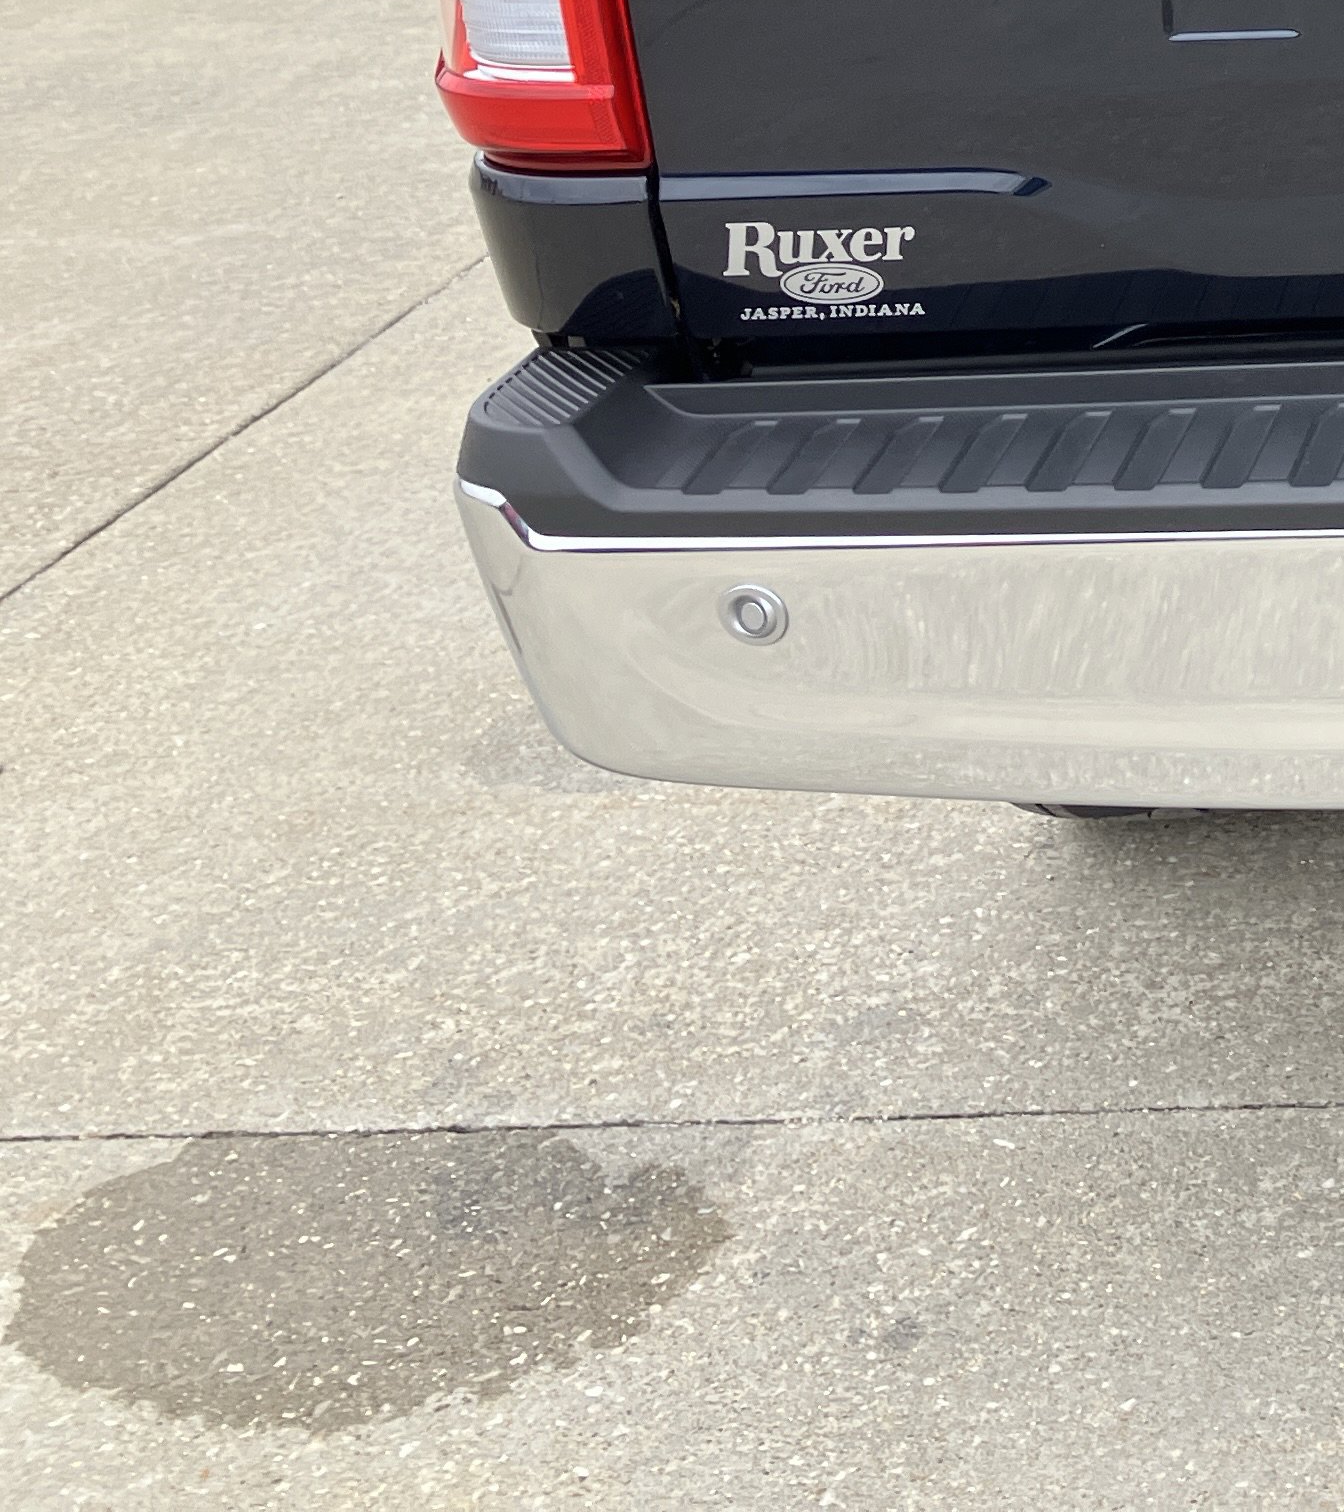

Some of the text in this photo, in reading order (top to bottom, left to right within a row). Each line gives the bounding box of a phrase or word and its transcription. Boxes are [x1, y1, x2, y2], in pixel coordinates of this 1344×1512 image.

[722, 221, 916, 278] Ruxer
[800, 271, 867, 294] Ford
[740, 302, 926, 321] JASPER, INDIANA
